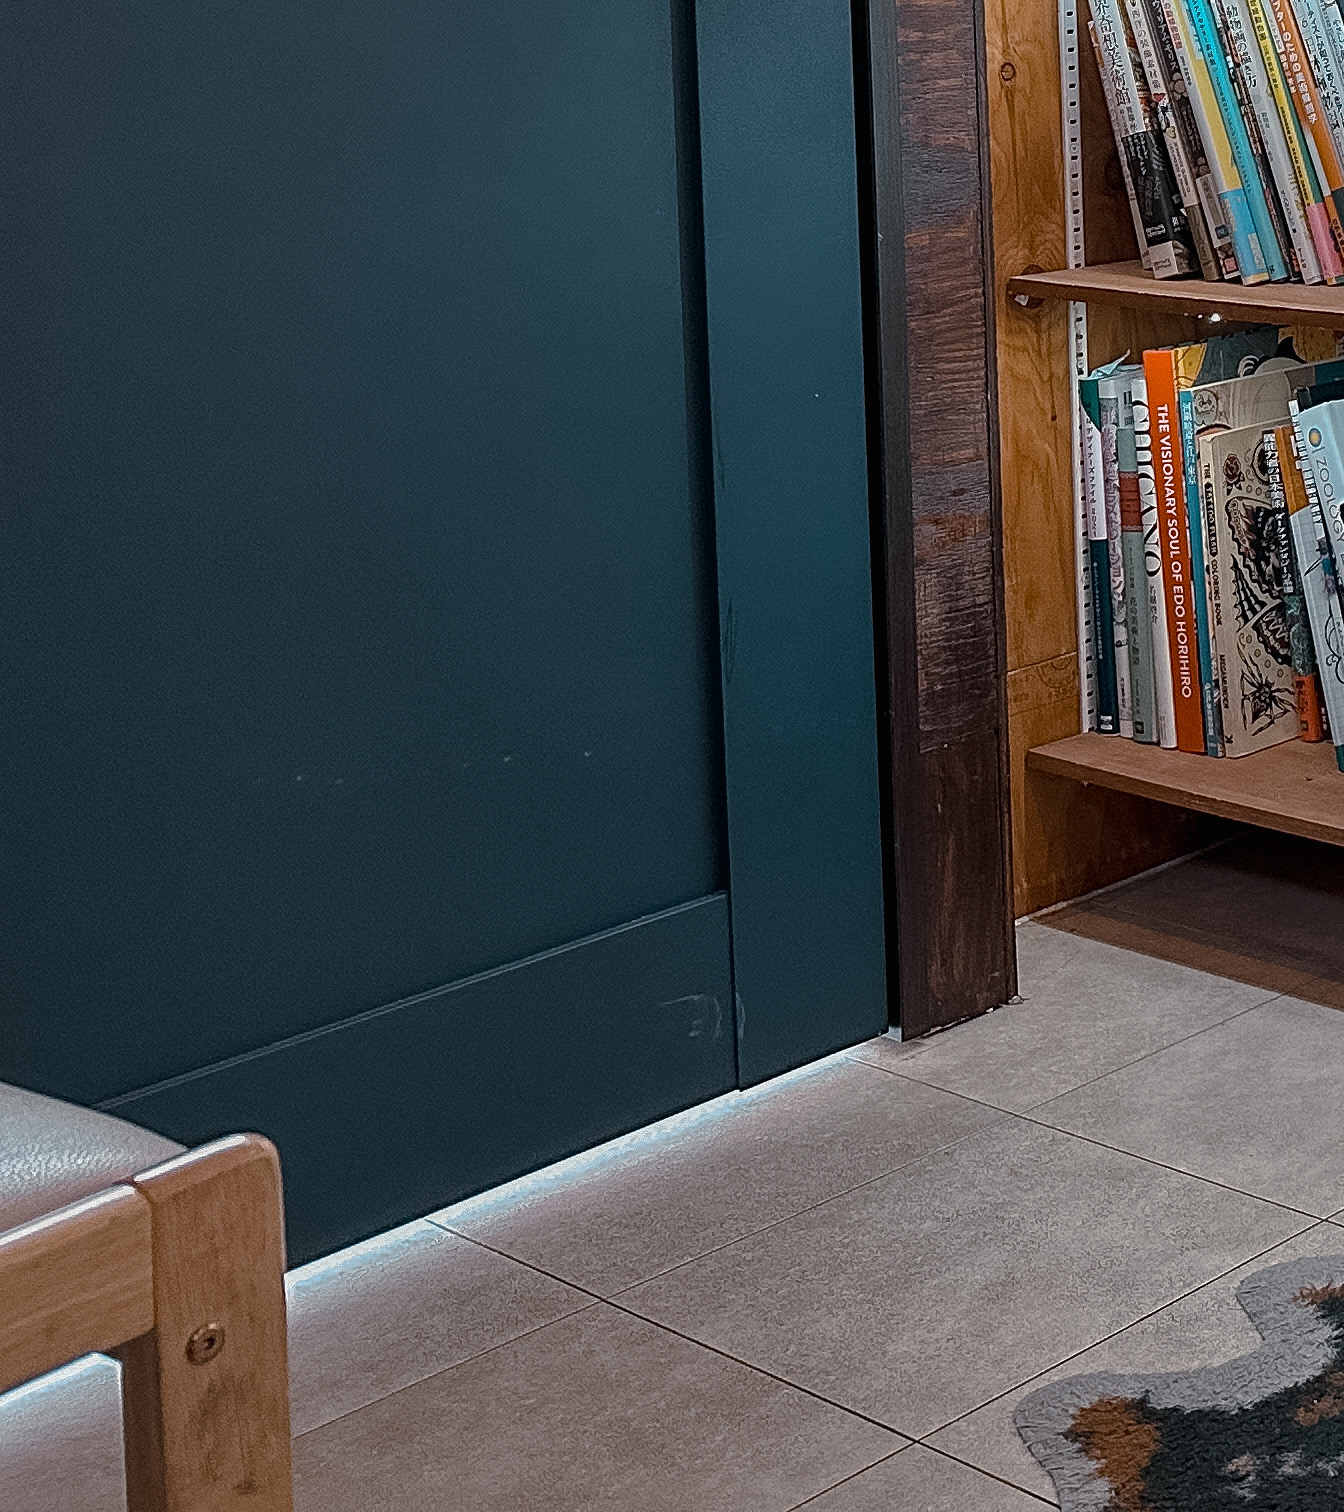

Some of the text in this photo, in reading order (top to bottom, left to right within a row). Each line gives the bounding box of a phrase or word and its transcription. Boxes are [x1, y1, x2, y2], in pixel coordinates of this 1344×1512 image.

[1156, 403, 1192, 700] THE VISIONARY SOUL OF EDO HORIHIRO
